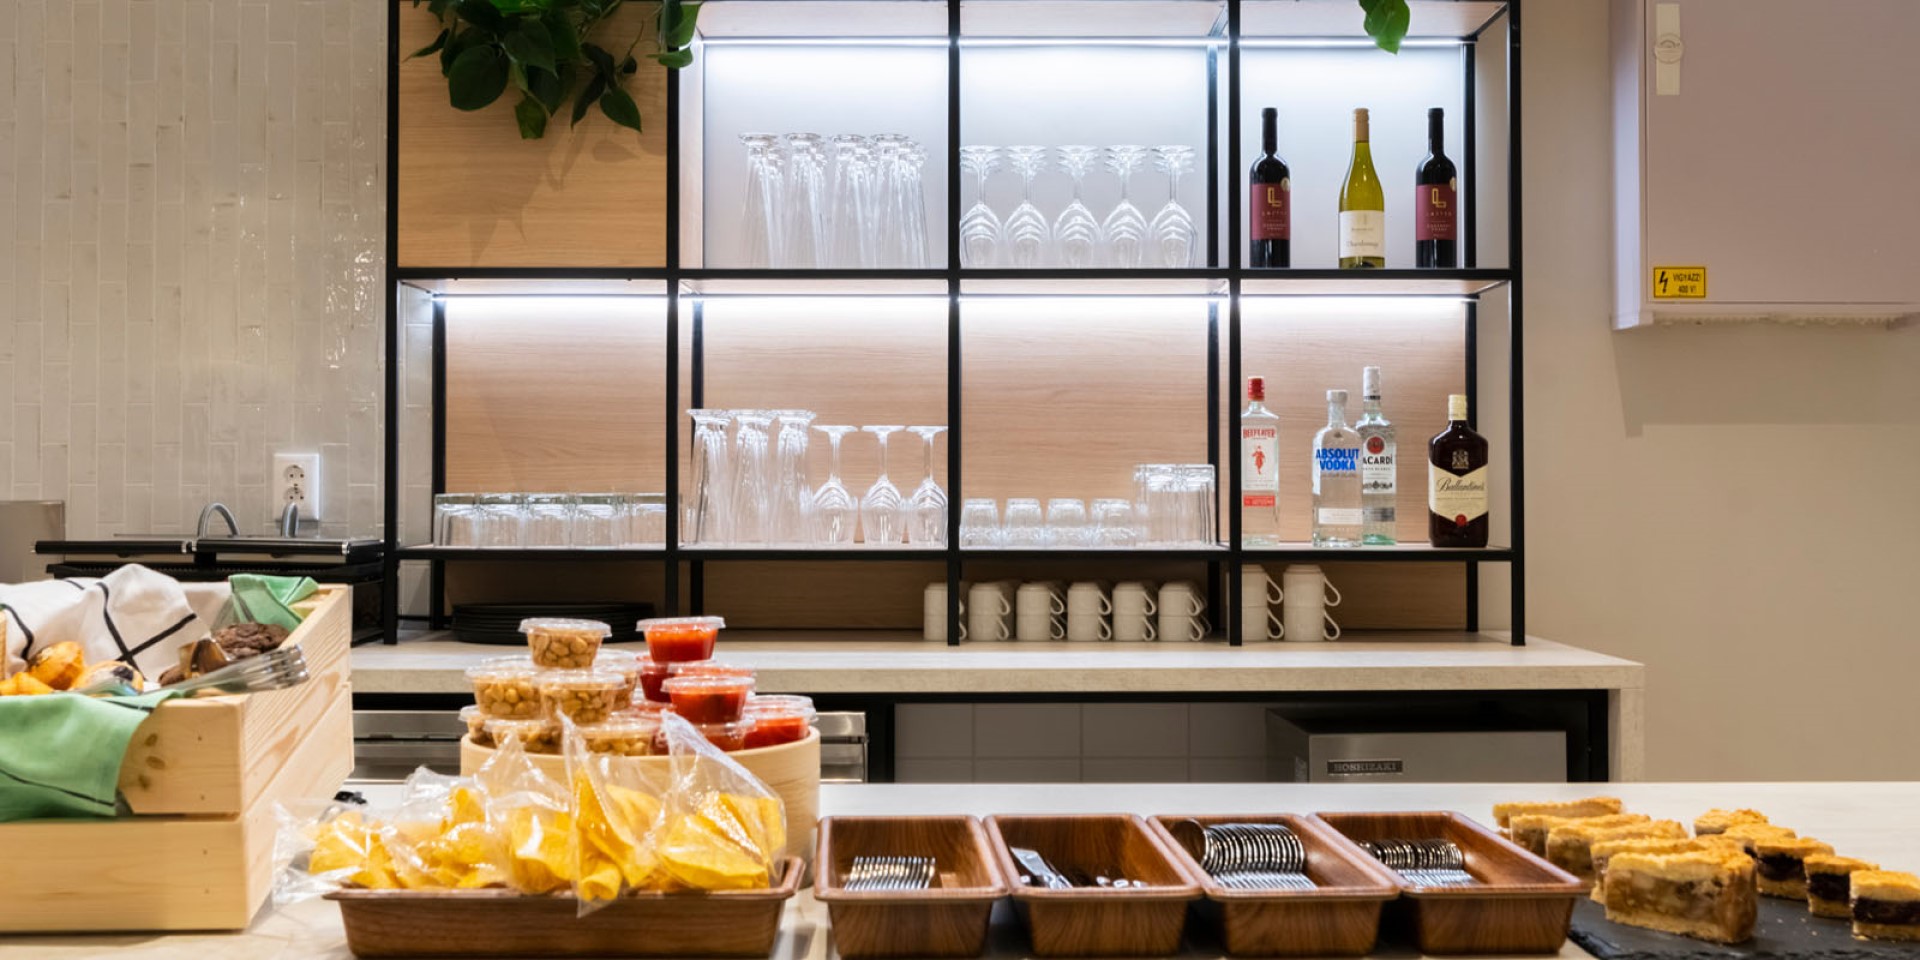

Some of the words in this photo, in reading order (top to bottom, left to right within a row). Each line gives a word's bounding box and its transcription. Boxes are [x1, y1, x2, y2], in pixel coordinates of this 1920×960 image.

[1243, 428, 1275, 438] BEEFEATER
[1316, 448, 1359, 459] ABSOLUT
[1320, 460, 1356, 470] VODKA
[1333, 763, 1397, 772] HOSHIZAKI
